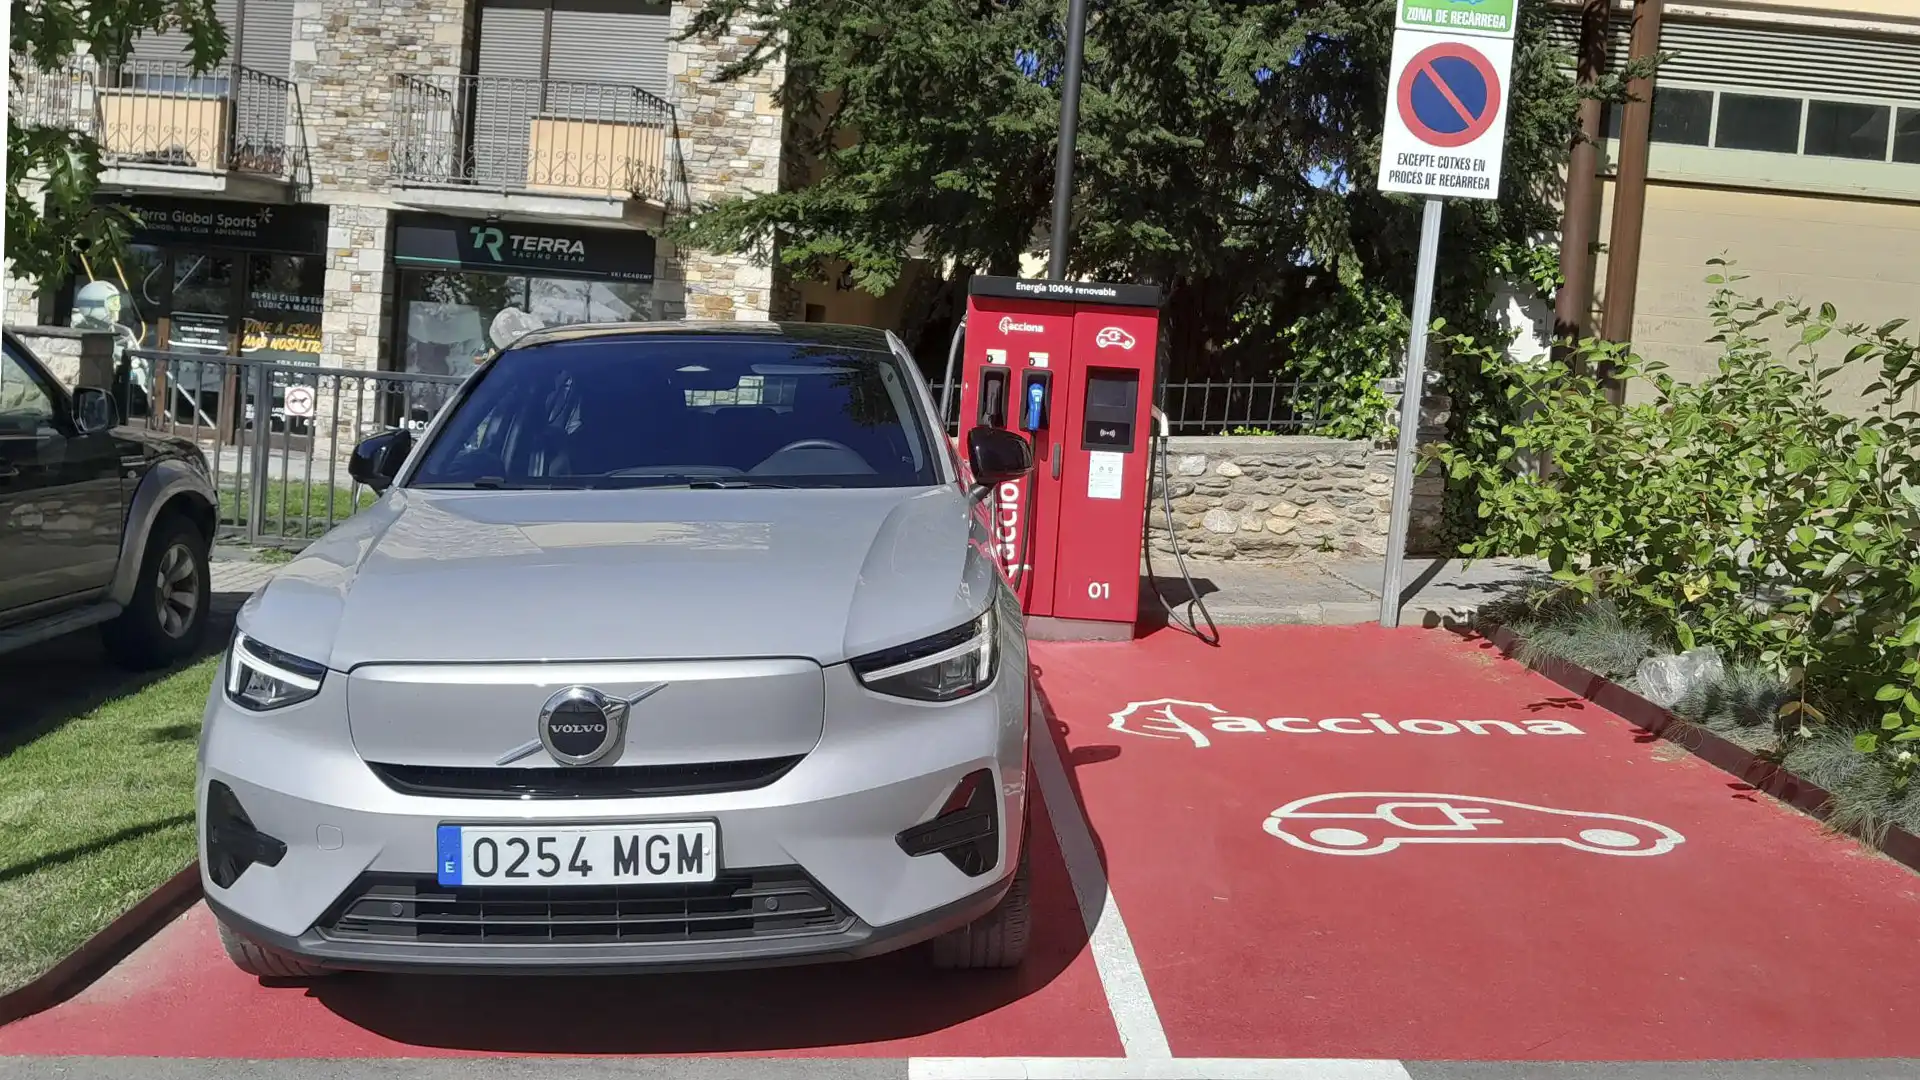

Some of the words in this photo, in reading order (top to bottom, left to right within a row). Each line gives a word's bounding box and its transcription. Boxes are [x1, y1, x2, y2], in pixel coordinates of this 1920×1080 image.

[1407, 7, 1432, 22] ZONA
[1435, 9, 1448, 23] DE
[1450, 10, 1506, 29] RECÀRREGA
[1397, 152, 1435, 168] EXCEPTE
[1437, 155, 1471, 171] COTXES
[1473, 158, 1486, 172] EN
[1425, 172, 1437, 186] DE
[1438, 172, 1490, 190] RECÀRREGA
[136, 207, 167, 221] Terra
[172, 210, 213, 225] Global
[216, 213, 257, 229] Sports
[510, 235, 585, 255] TERRA
[557, 255, 585, 263] TEAM
[623, 272, 652, 280] ACADEMY
[1016, 282, 1047, 294] Energía
[1048, 284, 1073, 294] 100%
[1075, 287, 1117, 297] renovable
[1009, 322, 1044, 333] acciona
[1088, 582, 1110, 599] 01
[551, 723, 605, 733] VOLVO
[1210, 712, 1586, 735] acciona
[445, 861, 455, 873] E
[473, 836, 593, 878] 0254
[613, 833, 703, 876] MGM
